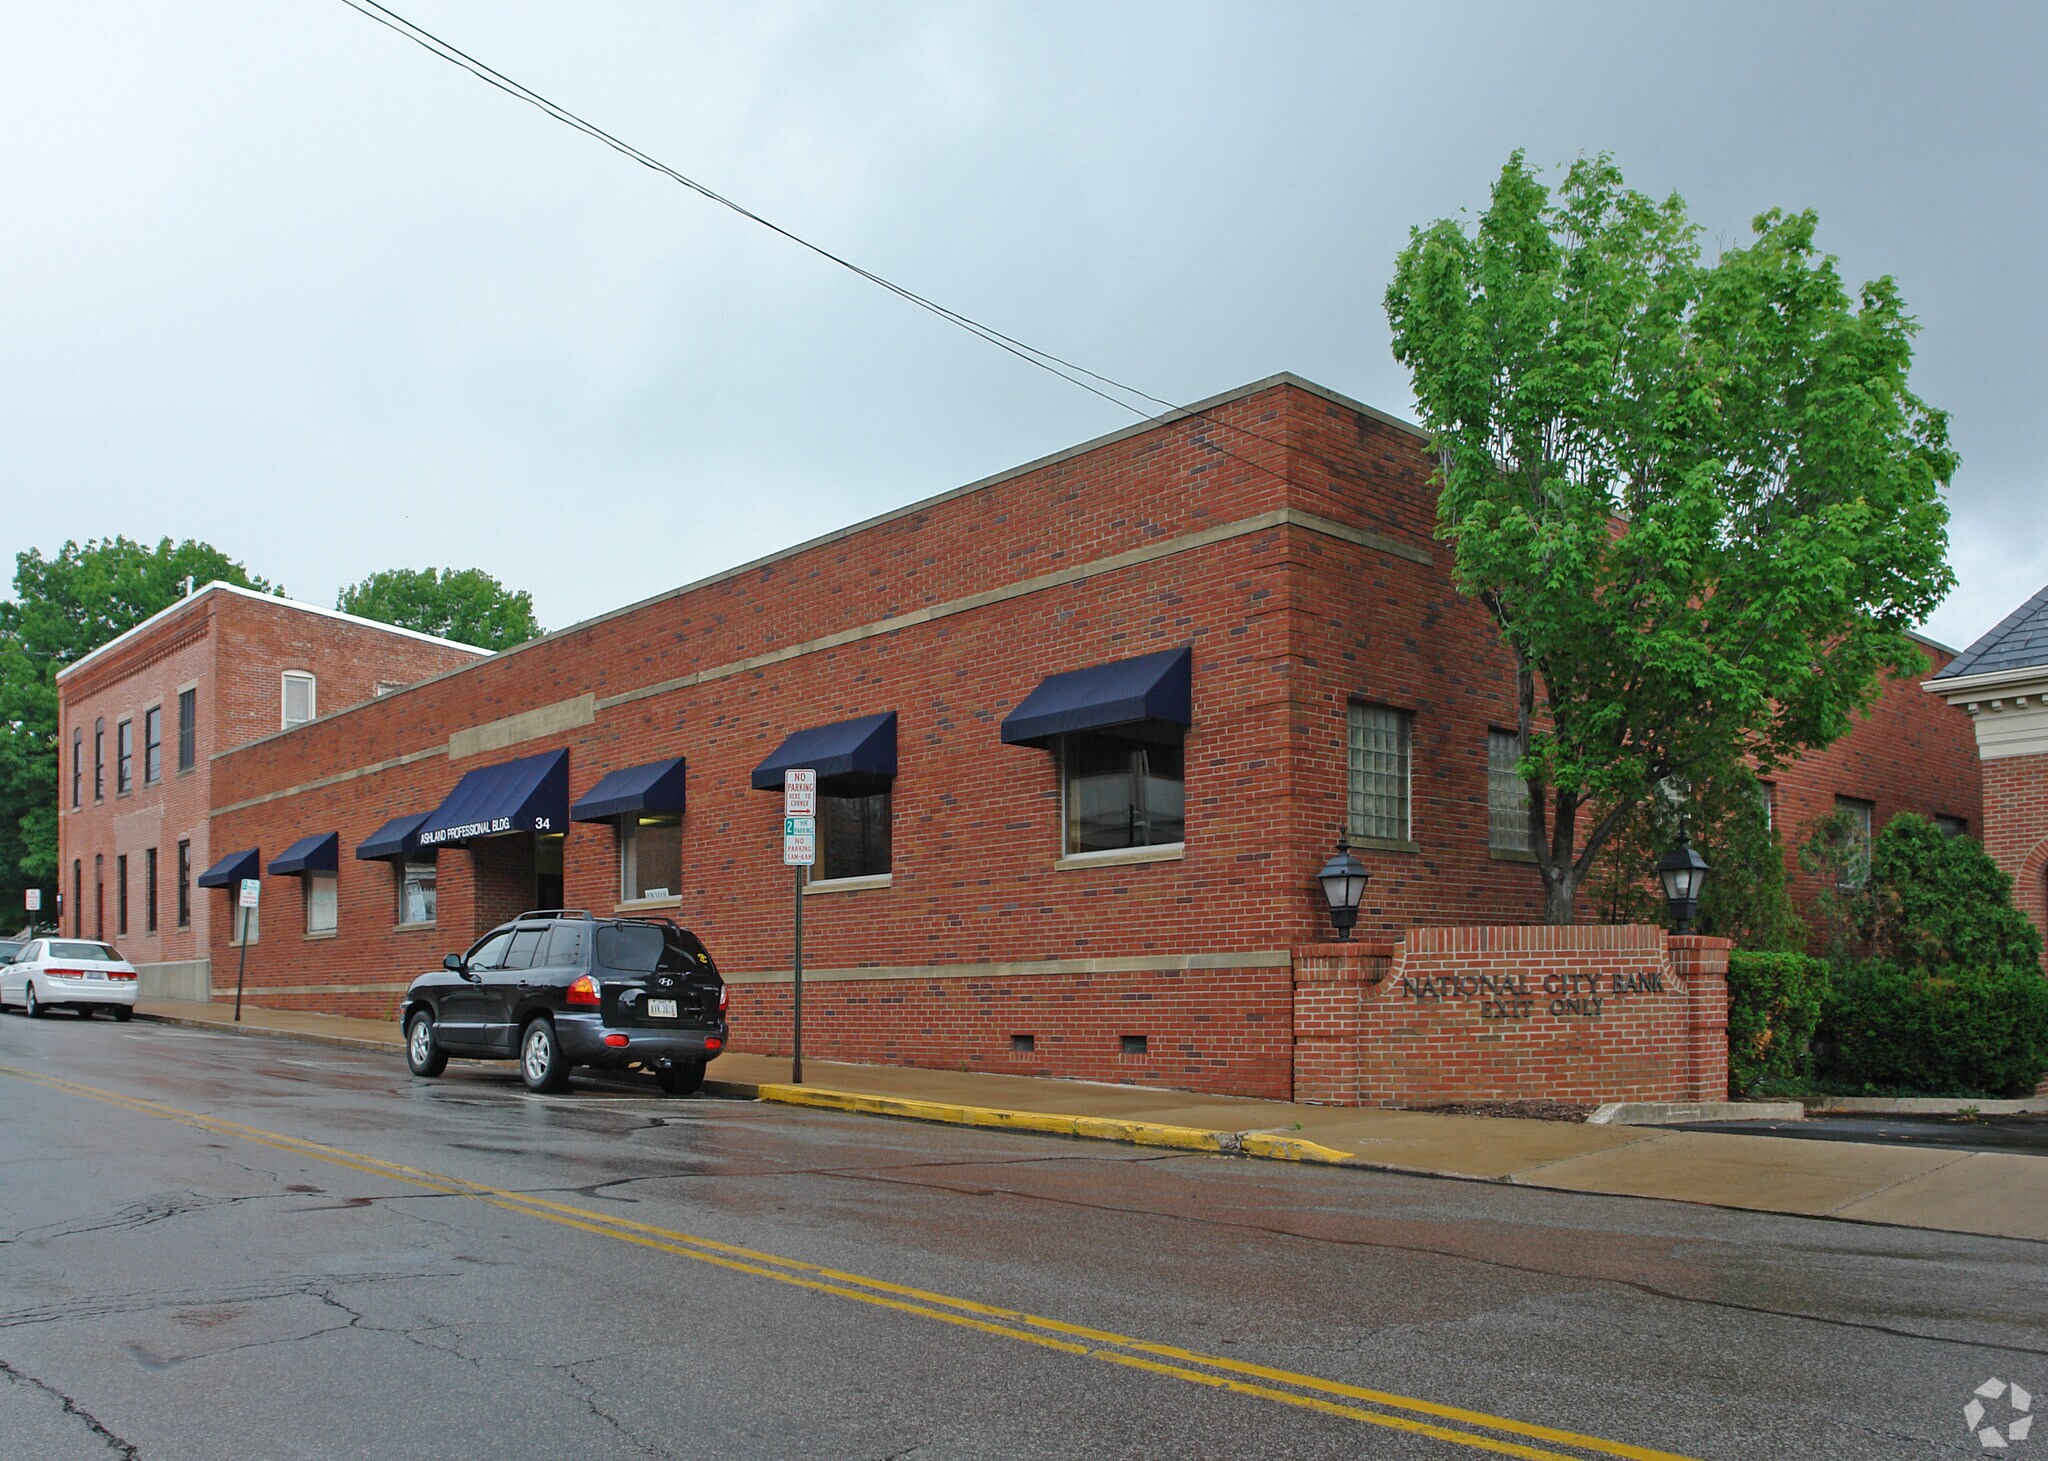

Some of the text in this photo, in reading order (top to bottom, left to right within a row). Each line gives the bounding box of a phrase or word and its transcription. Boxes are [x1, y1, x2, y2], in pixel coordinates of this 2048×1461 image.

[795, 772, 806, 782] NO
[787, 783, 814, 791] PARKING
[534, 816, 551, 830] 34
[787, 821, 793, 833] 2
[420, 816, 511, 845] ASHLAND PROFESSIONAL BLDG.
[794, 837, 805, 845] NO
[1403, 971, 1665, 998] NATIONAL CITY BANK
[1481, 997, 1604, 1019] EXIT ONLY
